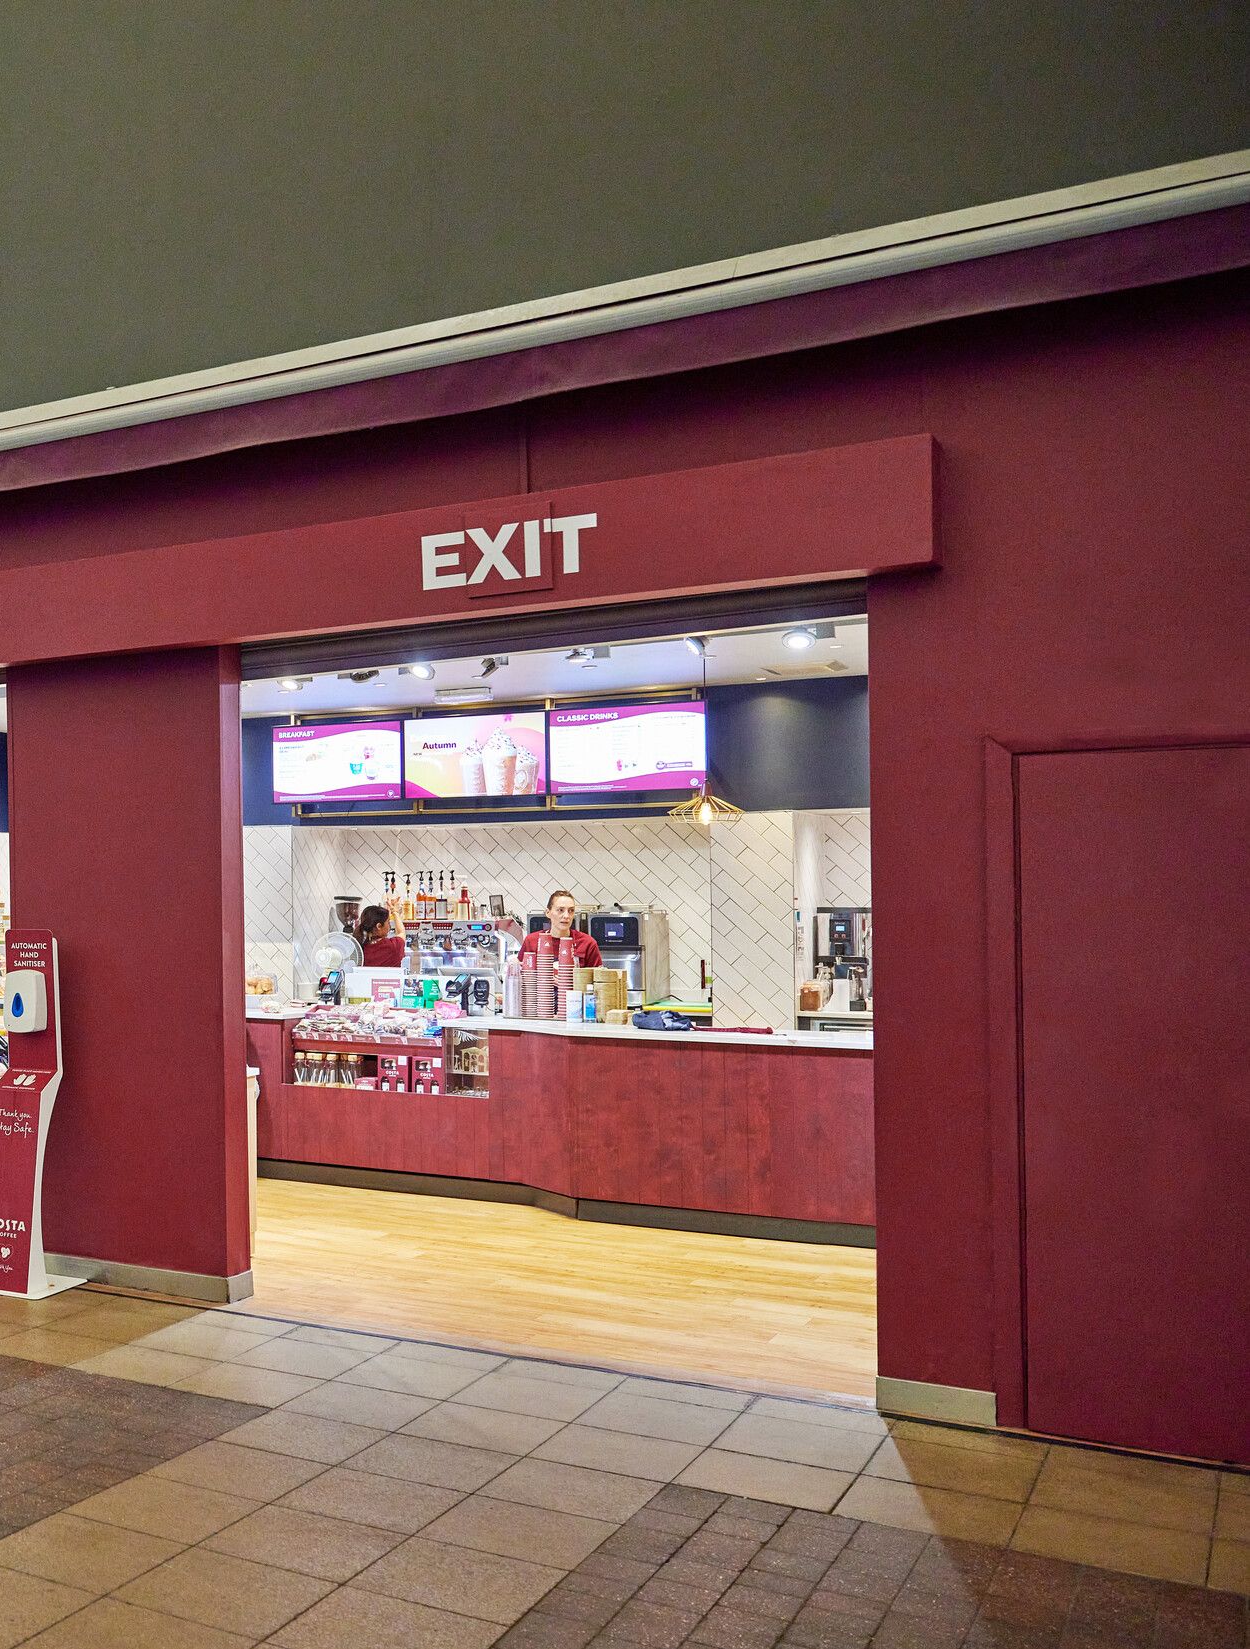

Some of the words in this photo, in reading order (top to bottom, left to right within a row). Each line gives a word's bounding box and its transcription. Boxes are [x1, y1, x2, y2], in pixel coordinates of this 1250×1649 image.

[421, 512, 597, 591] EXIT
[556, 714, 589, 723] CLASSIC
[589, 711, 619, 721] DRINKS
[278, 731, 315, 739] BREAKFAST
[422, 742, 457, 750] Autumn
[11, 942, 48, 950] AUTOMATIC
